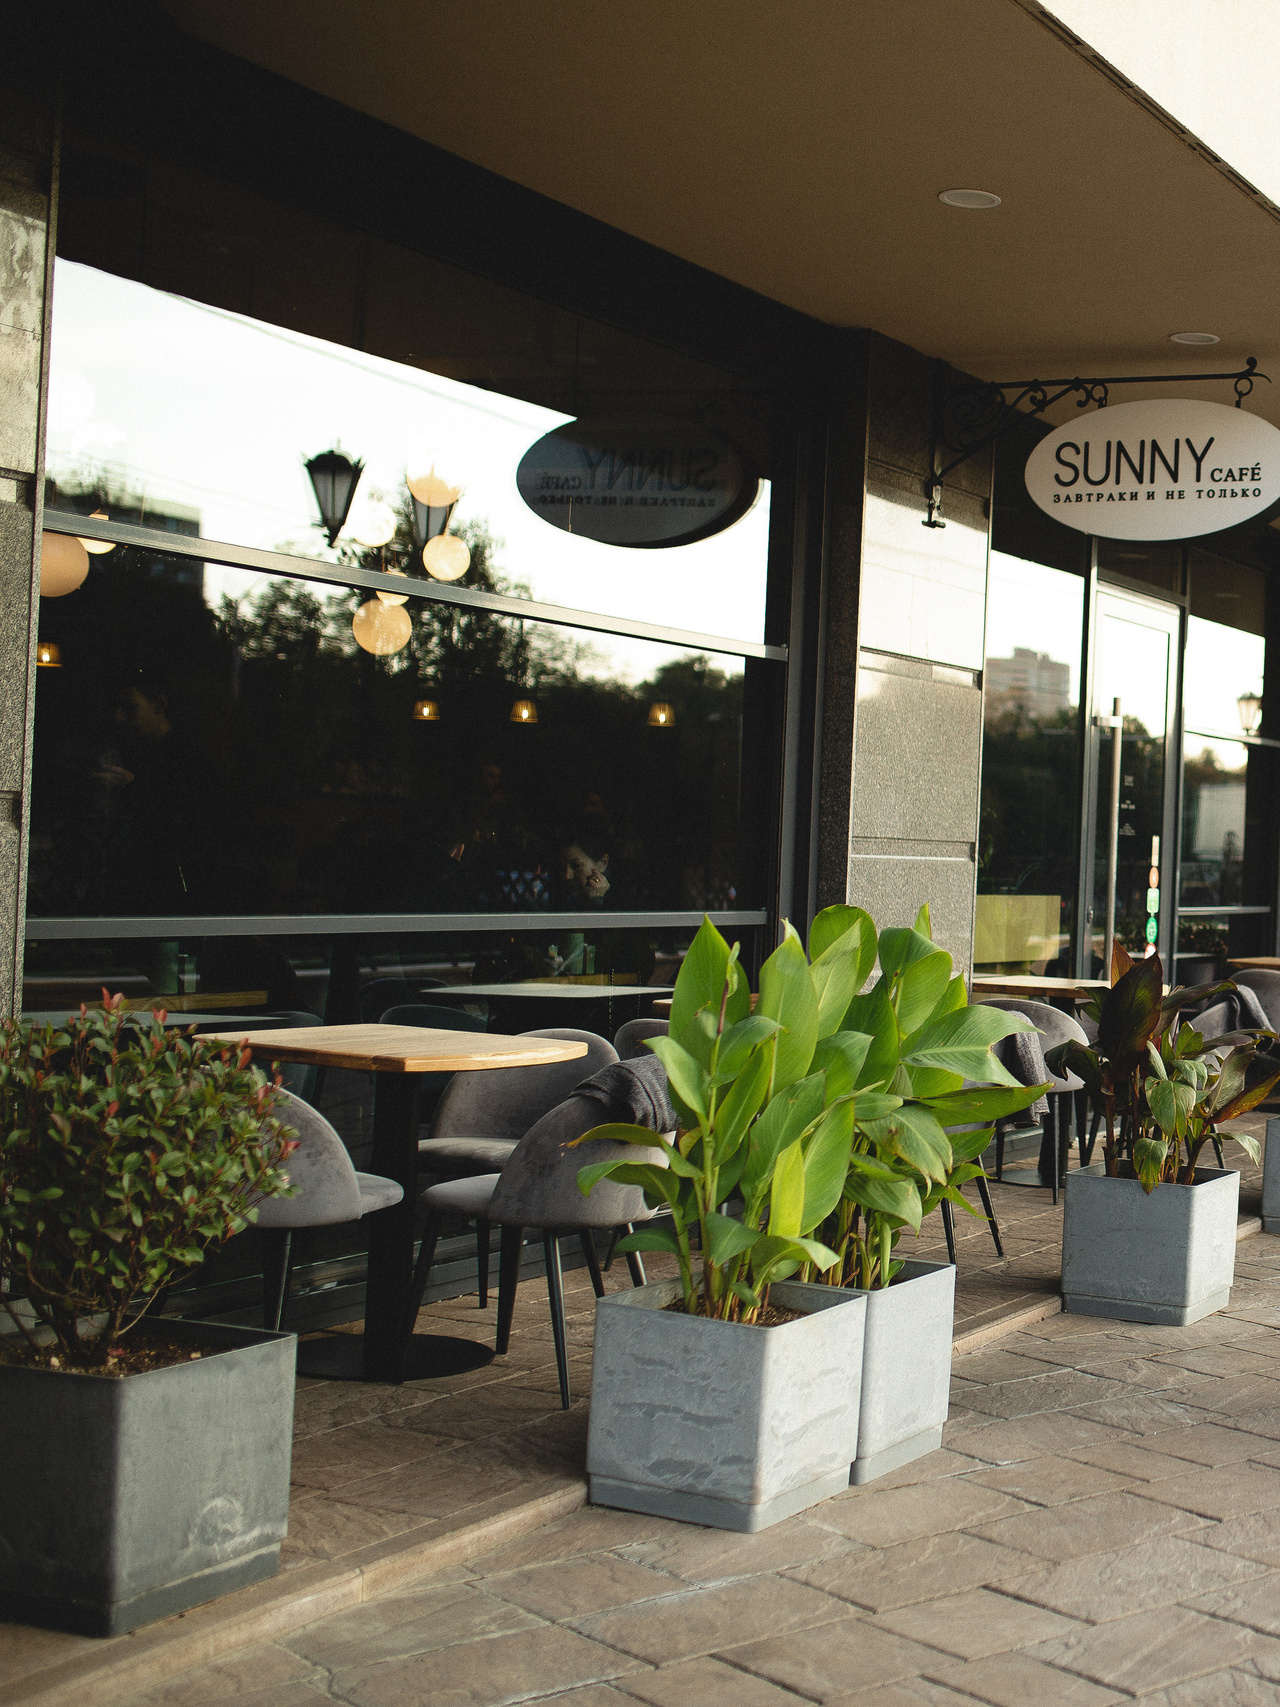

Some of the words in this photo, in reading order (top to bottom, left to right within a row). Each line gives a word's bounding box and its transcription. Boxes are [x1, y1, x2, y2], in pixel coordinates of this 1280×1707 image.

[1054, 436, 1215, 488] SUNNY
[1210, 462, 1262, 483] CAFÉ
[1053, 490, 1139, 504] ЗАВТРАКИ
[1146, 490, 1156, 501] И
[1165, 490, 1186, 500] НЕ
[1196, 487, 1263, 499] ТОЛЬКО
